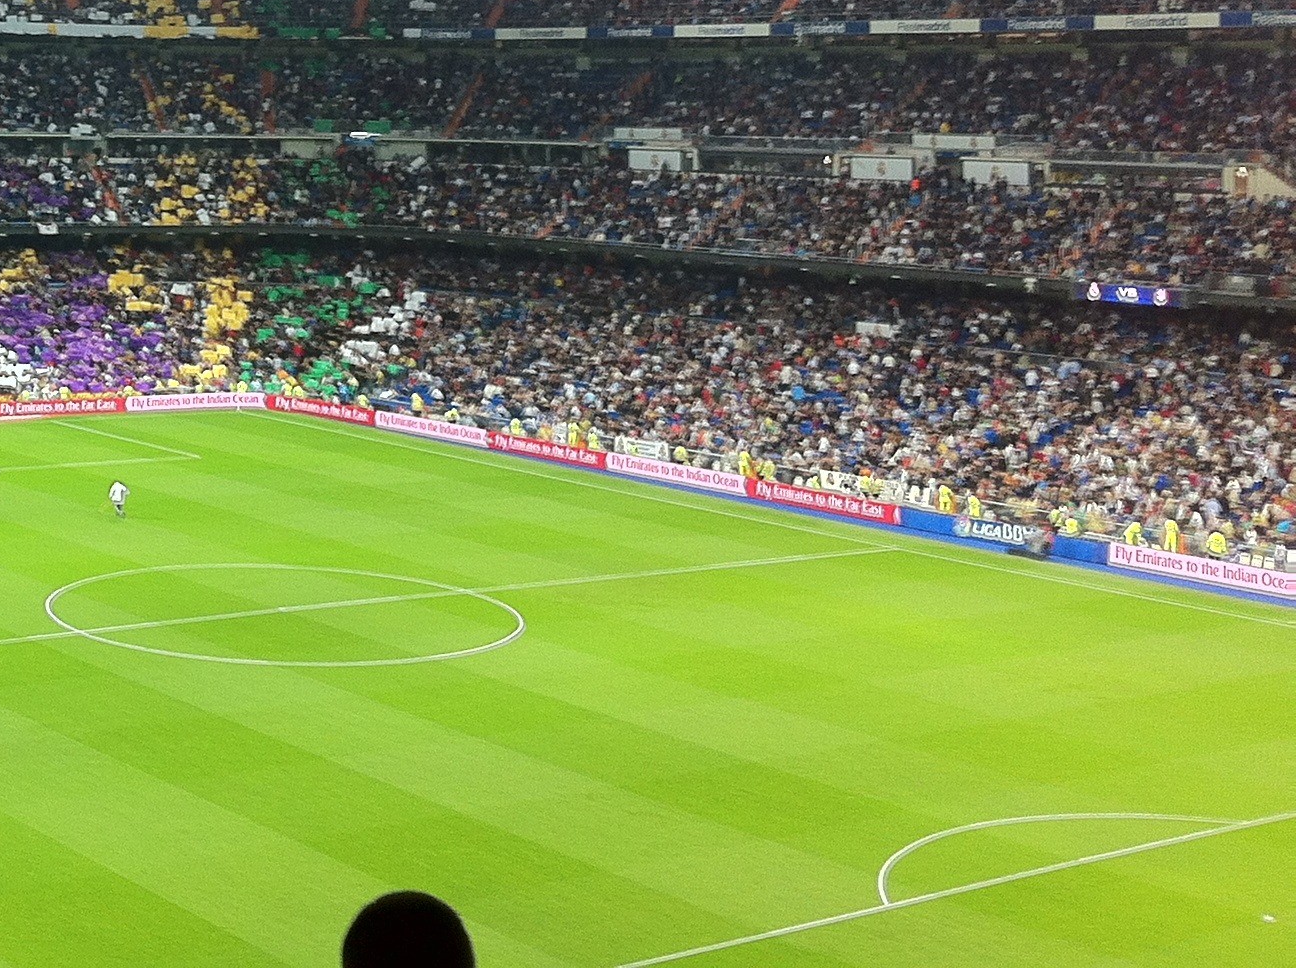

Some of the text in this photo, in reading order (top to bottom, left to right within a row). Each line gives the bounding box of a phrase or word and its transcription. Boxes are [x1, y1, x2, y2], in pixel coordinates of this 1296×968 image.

[0, 399, 116, 416] Fly Emirates to the Far East
[131, 394, 259, 409] Fly Emirates to the Indian Ocean
[275, 396, 369, 422] Fly Emirates to the Far East
[379, 412, 482, 440] Fly Emirates to the Indian Ocean
[494, 434, 598, 464] Fly Emirates to the Far East
[611, 455, 739, 488] Fly Emirates to the Indian Ocean
[756, 481, 885, 517] Fly Emirates to the Far East
[1115, 546, 1296, 590] Fly Emirates to the Indian Oce
